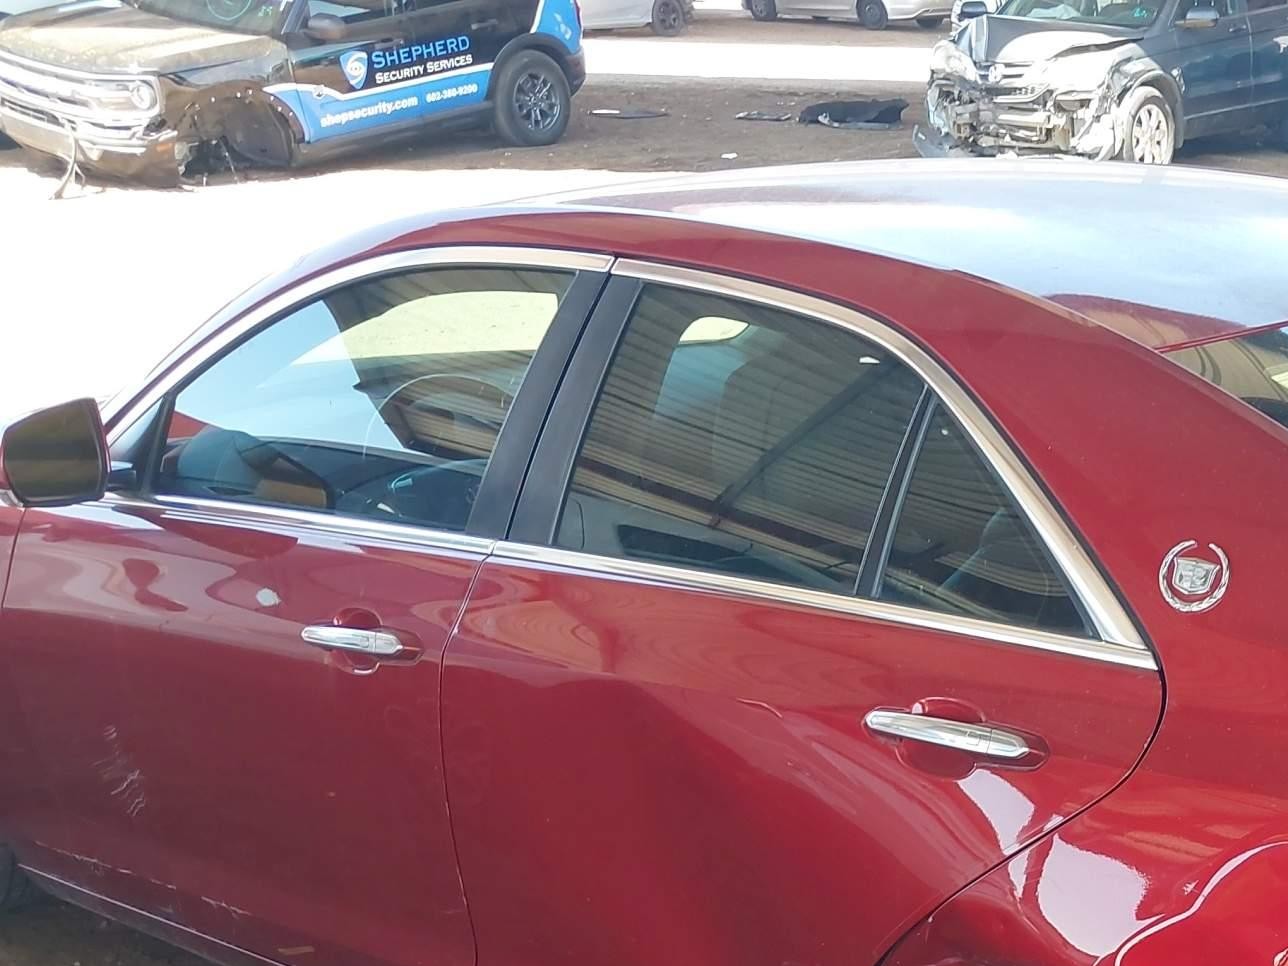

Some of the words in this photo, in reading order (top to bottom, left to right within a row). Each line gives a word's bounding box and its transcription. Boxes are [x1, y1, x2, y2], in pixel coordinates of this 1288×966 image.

[371, 36, 470, 69] SHEPHERD
[375, 65, 425, 84] SECURITY
[426, 54, 473, 73] SERVICES
